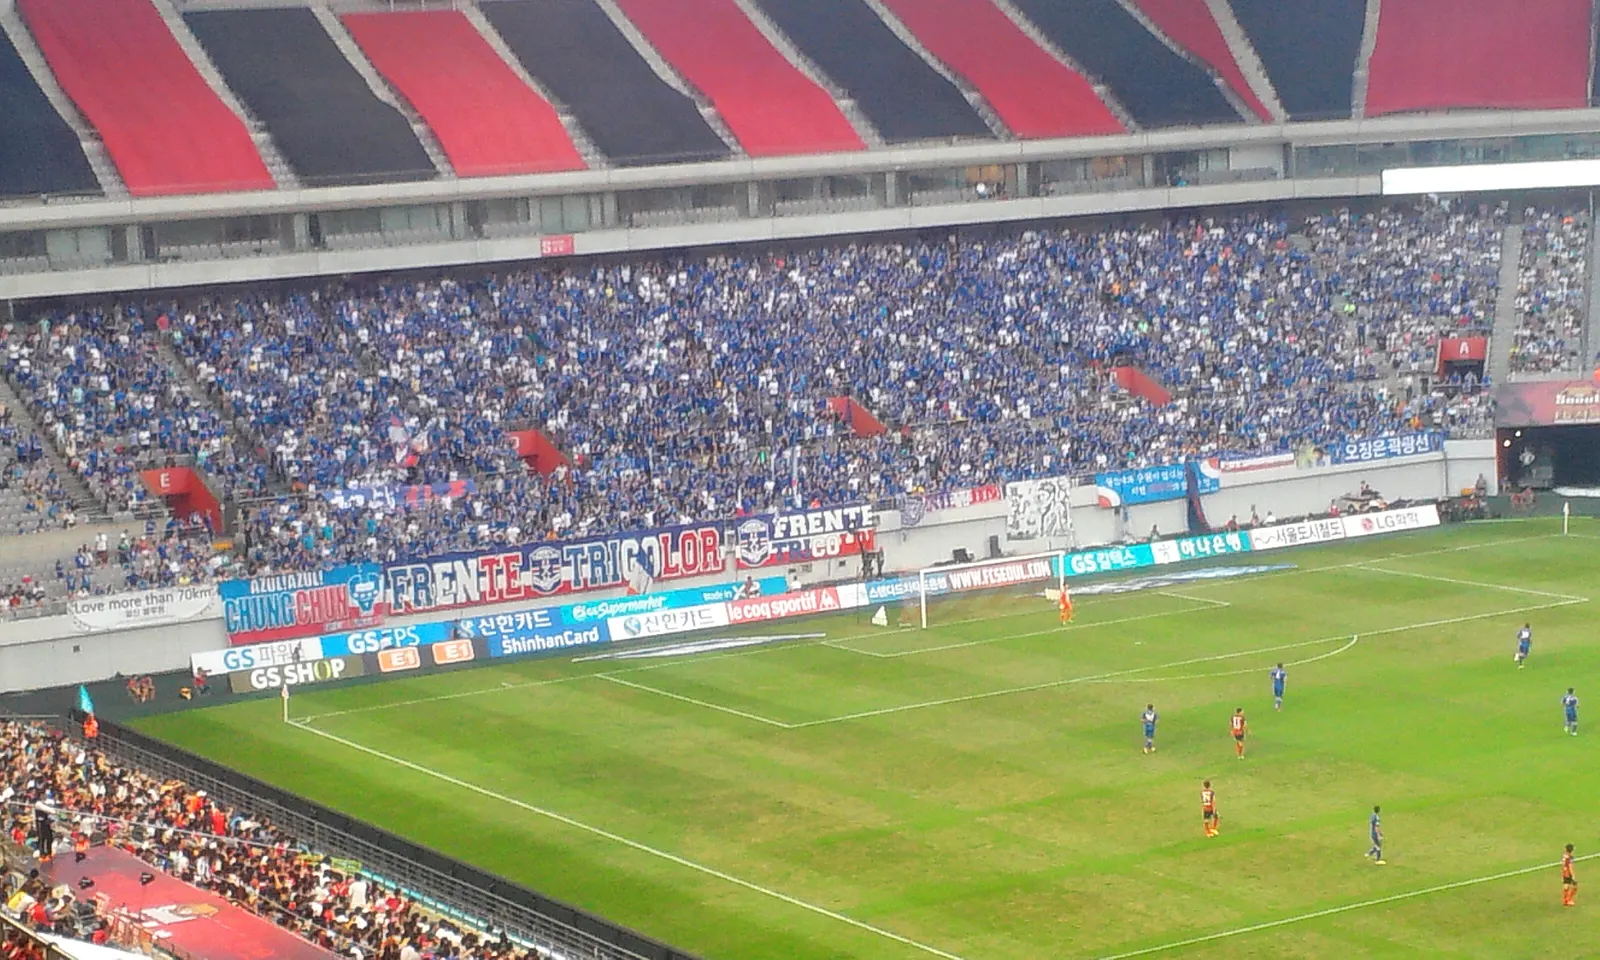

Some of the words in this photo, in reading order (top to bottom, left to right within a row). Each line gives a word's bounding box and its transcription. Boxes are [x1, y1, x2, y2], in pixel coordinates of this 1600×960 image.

[1459, 341, 1470, 355] A
[160, 472, 171, 488] E
[772, 505, 873, 538] FRENTE
[1275, 520, 1343, 543] 서울도시철도
[1181, 532, 1241, 557] 하나은행
[387, 552, 523, 614] FRENTE
[561, 526, 722, 590] TRICOLOR
[949, 559, 1051, 590] WWW.FCSEOUL.COM
[74, 602, 105, 615] Love
[108, 599, 142, 611] more
[145, 592, 174, 606] than
[178, 588, 212, 601] 70km
[727, 603, 742, 620] le
[742, 600, 772, 619] coq
[771, 591, 818, 616] sportif
[477, 609, 553, 637] 신한카드
[643, 608, 716, 633] 신한카드
[348, 631, 378, 654] GS
[445, 642, 469, 658] E1
[224, 649, 254, 670] GS
[391, 649, 416, 666] E1
[250, 668, 281, 689] GS
[284, 658, 345, 686] SHOP
